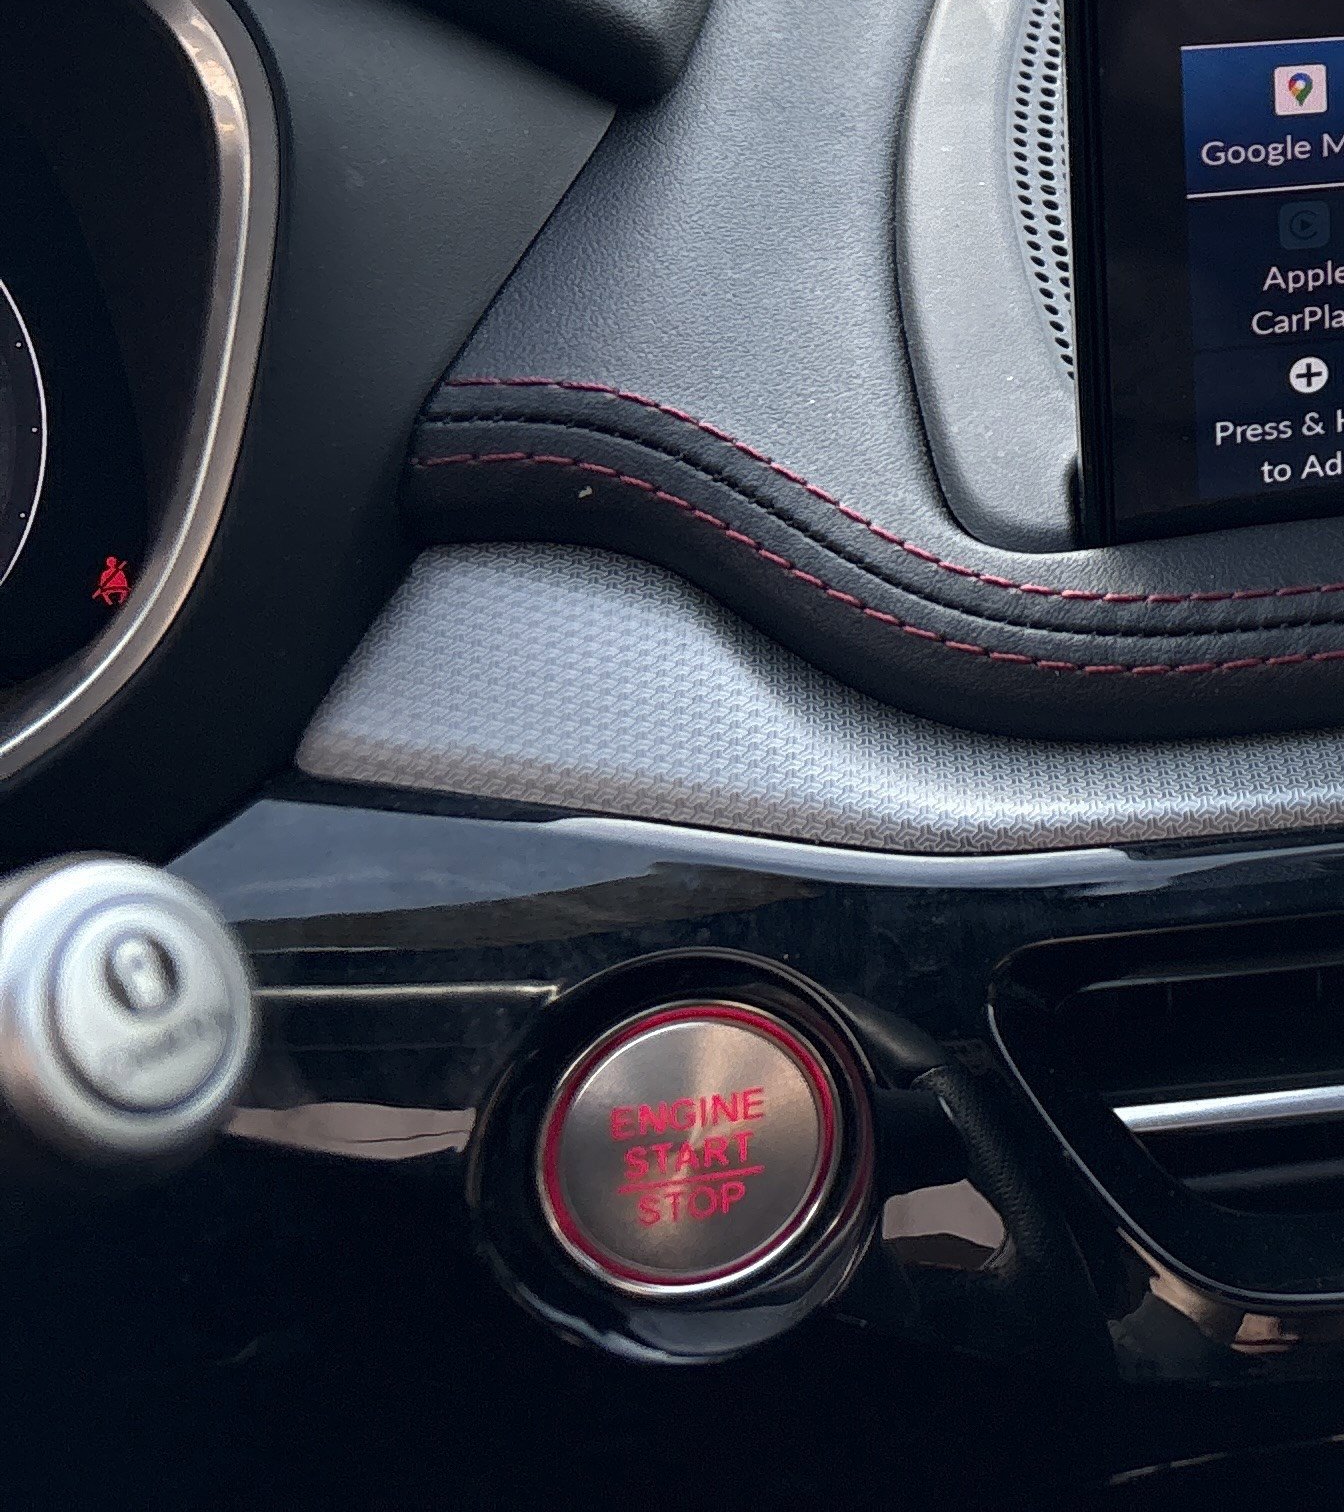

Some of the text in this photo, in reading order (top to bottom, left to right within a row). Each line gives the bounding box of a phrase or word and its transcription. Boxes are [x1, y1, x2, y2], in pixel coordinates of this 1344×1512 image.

[1201, 133, 1311, 168] Google
[1215, 417, 1292, 446] Press
[1302, 412, 1325, 437] &
[1262, 459, 1292, 484] to
[611, 1087, 765, 1140] ENGINE
[625, 1131, 754, 1180] START
[637, 1182, 746, 1228] STOP
